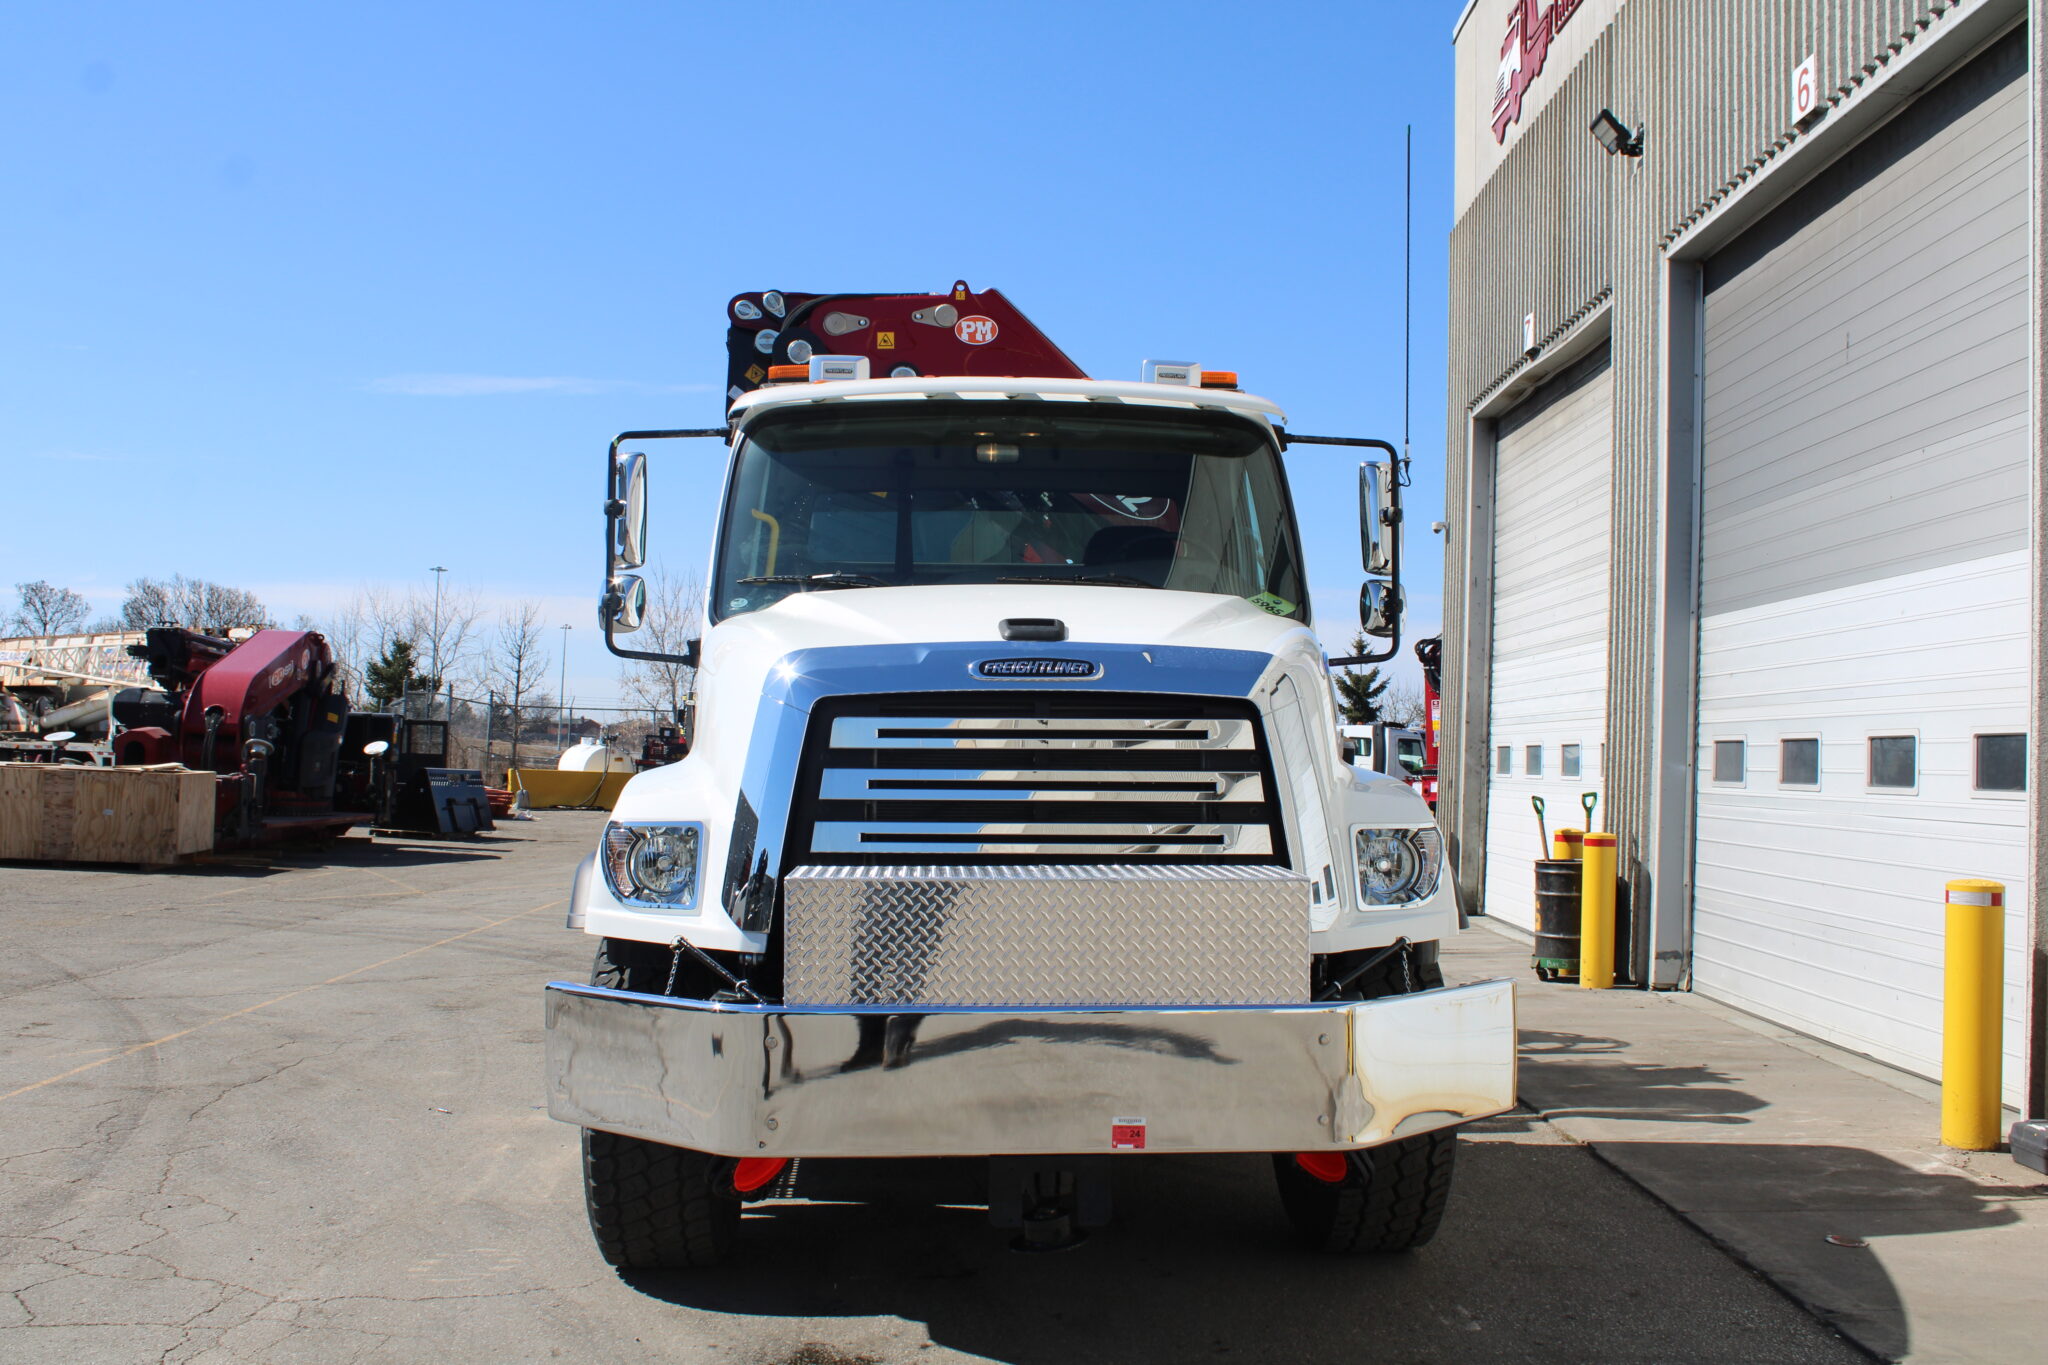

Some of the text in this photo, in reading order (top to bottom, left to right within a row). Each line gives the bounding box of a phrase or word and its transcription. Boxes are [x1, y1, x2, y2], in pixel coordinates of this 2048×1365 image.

[1798, 67, 1809, 112] 6
[961, 321, 992, 341] PM
[983, 660, 1089, 674] FREIGHTLINER
